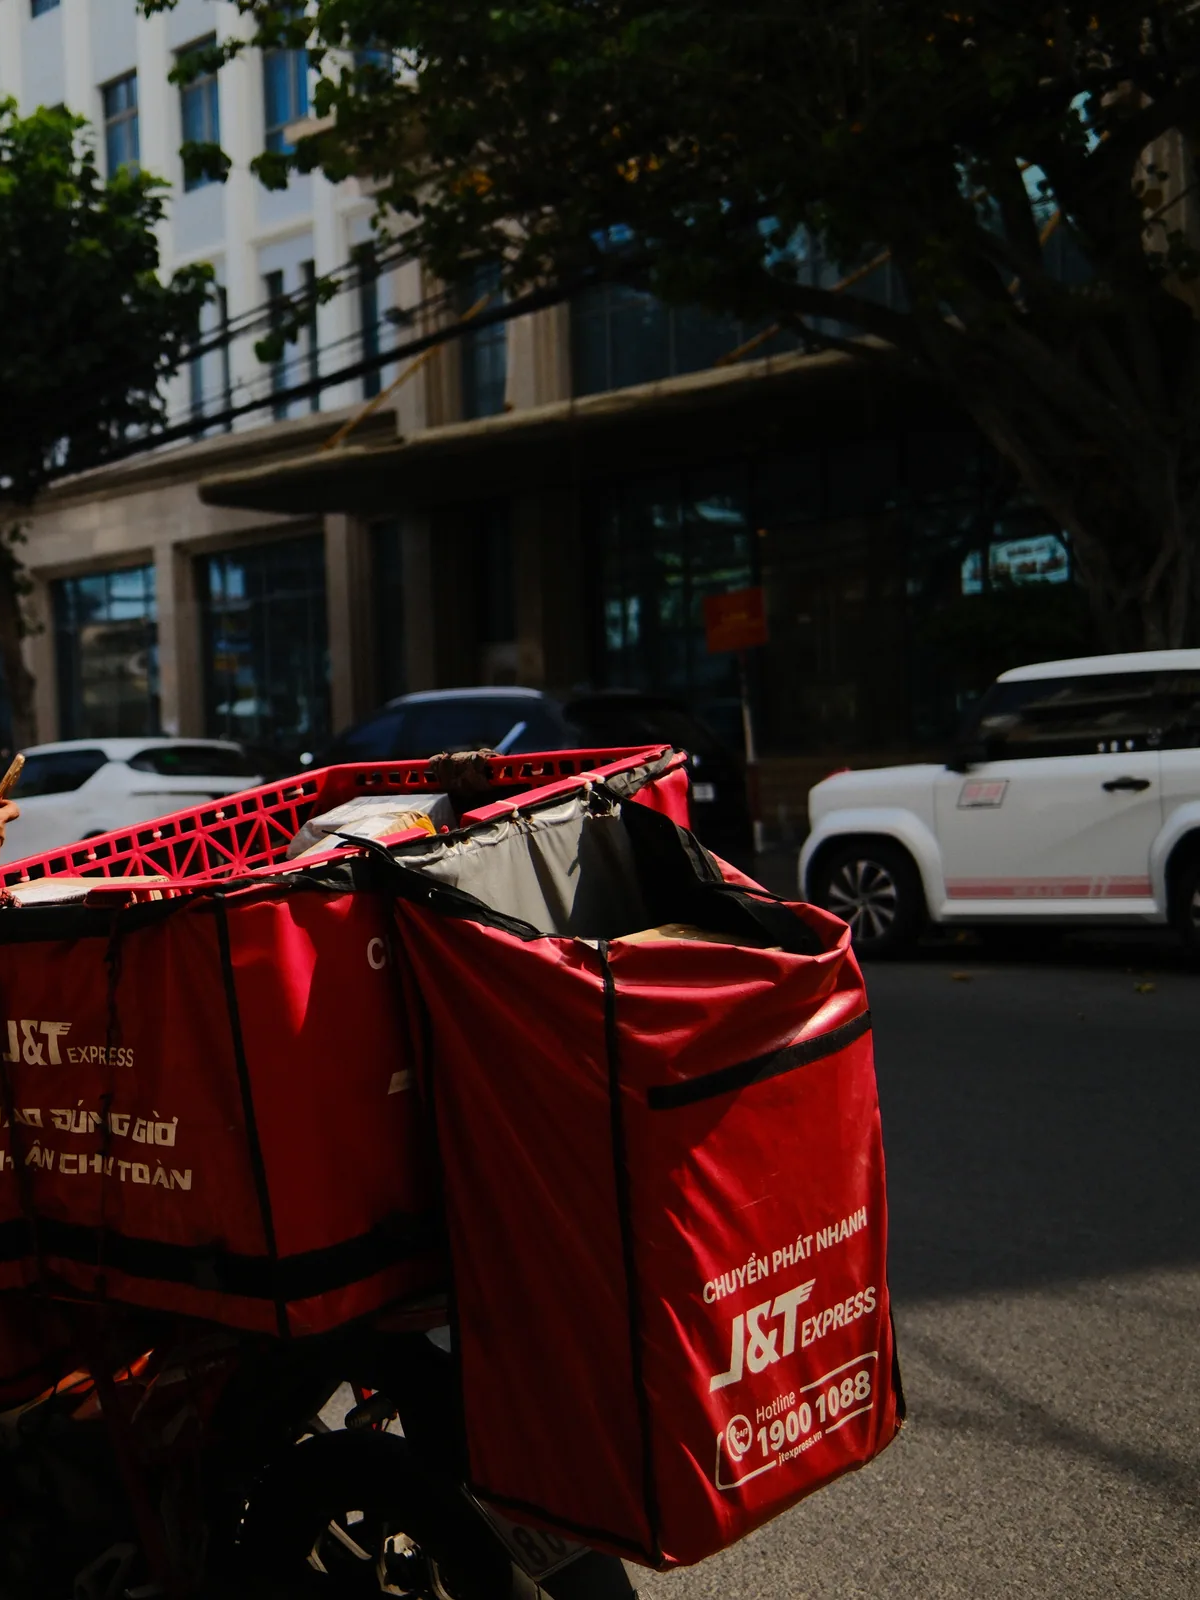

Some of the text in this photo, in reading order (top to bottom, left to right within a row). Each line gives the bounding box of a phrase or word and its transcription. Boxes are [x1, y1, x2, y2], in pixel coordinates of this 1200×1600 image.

[2, 1019, 134, 1068] J&T EXPRESS
[132, 1110, 178, 1147] GIỜ
[117, 1158, 192, 1191] TOÀN
[702, 1205, 869, 1306] CHUYỂN PHÁT NHANH
[709, 1277, 877, 1392] J&T EXPRESS
[755, 1390, 797, 1425] Hotline
[756, 1402, 813, 1458] 1900
[814, 1370, 872, 1424] 1088
[777, 1430, 823, 1467] jtexpress.vn
